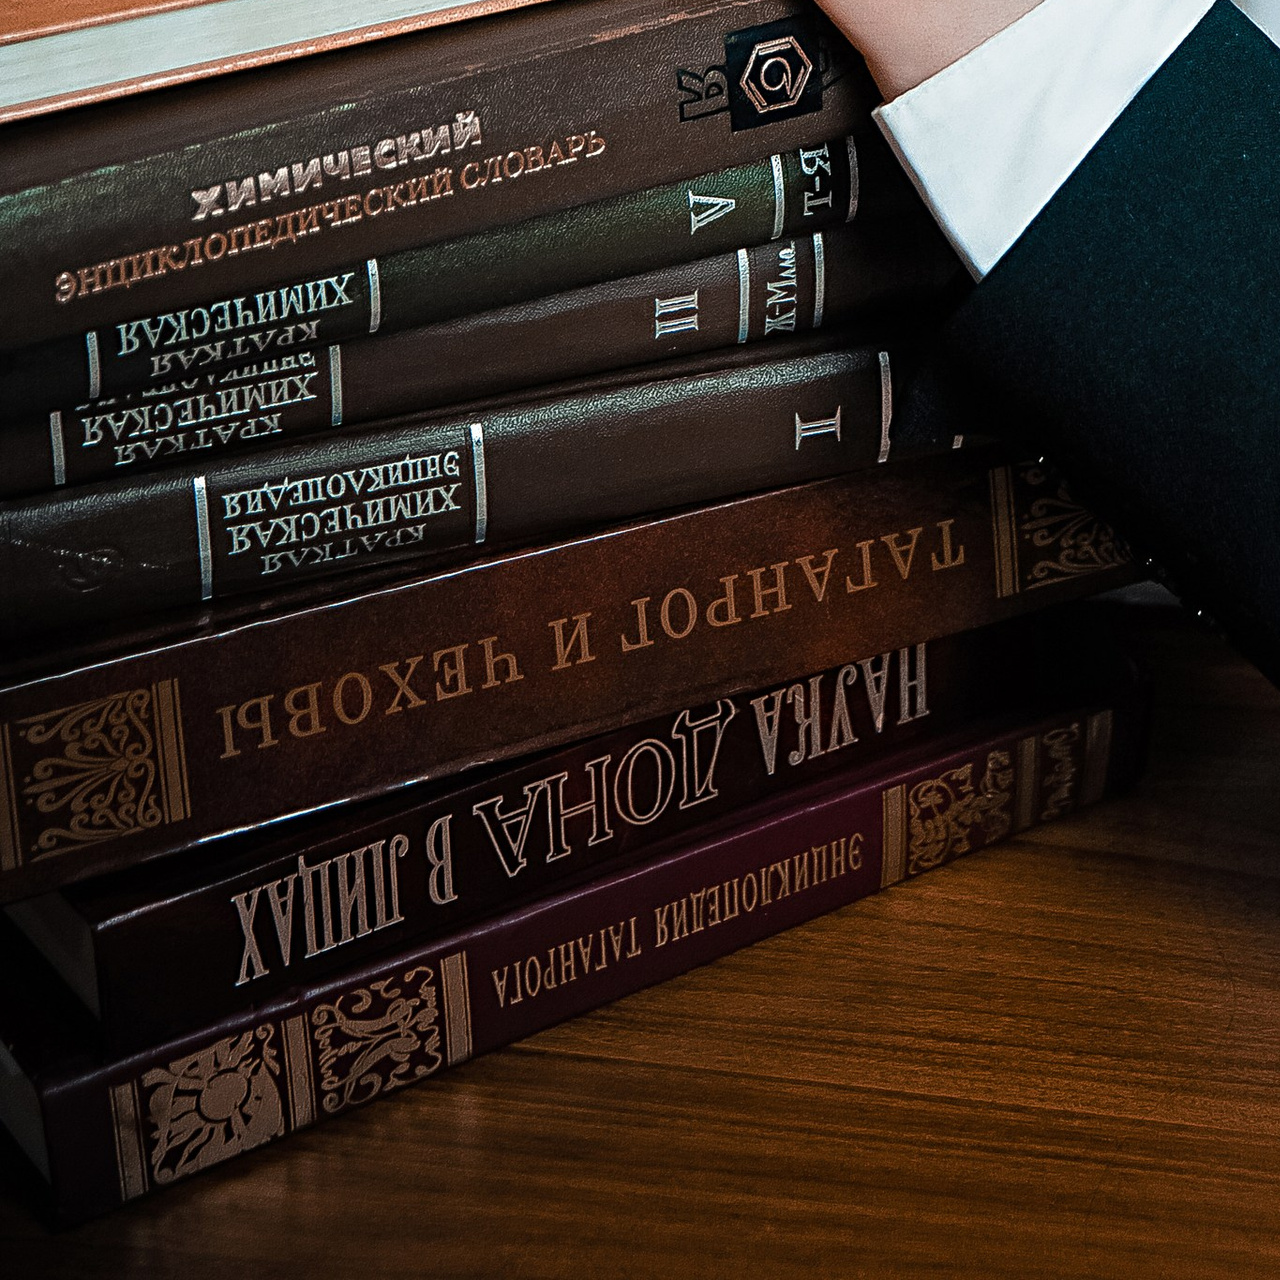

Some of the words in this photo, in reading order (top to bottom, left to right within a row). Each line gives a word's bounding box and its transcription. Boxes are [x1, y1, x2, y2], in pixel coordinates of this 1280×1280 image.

[191, 110, 482, 221] ХИМИЧЕСКИЙ
[54, 167, 454, 303] ЭНЦИКЛОПЕДИЧЕСКИЙ
[459, 130, 606, 190] СЛОВАРЬ
[688, 190, 736, 235] V
[115, 272, 355, 356] ХИМИЧЕСКАЯ
[150, 319, 322, 377] КРАТКАЯ
[81, 371, 319, 447] ХИМИЧЕСКАЯ
[113, 412, 283, 467] КРАТКАЯ
[221, 450, 461, 519] ЭНЦИКЛОПЕДИЯ
[226, 483, 462, 555] ХИМИЧЕСКАЯ
[261, 523, 427, 575] КРАТКАЯ
[620, 518, 966, 652] ТАГАНРОГ
[548, 612, 596, 671] И
[215, 635, 524, 759] ЧЕХОВЫ
[750, 642, 930, 776] НАУКА
[473, 698, 739, 878] ДОНА
[426, 814, 458, 905] В
[654, 832, 864, 948] ЭНЦИКЛОПЕДИЯ
[231, 834, 409, 987] ЛИЦАХ
[491, 916, 641, 1008] ТАГАНРОГА
